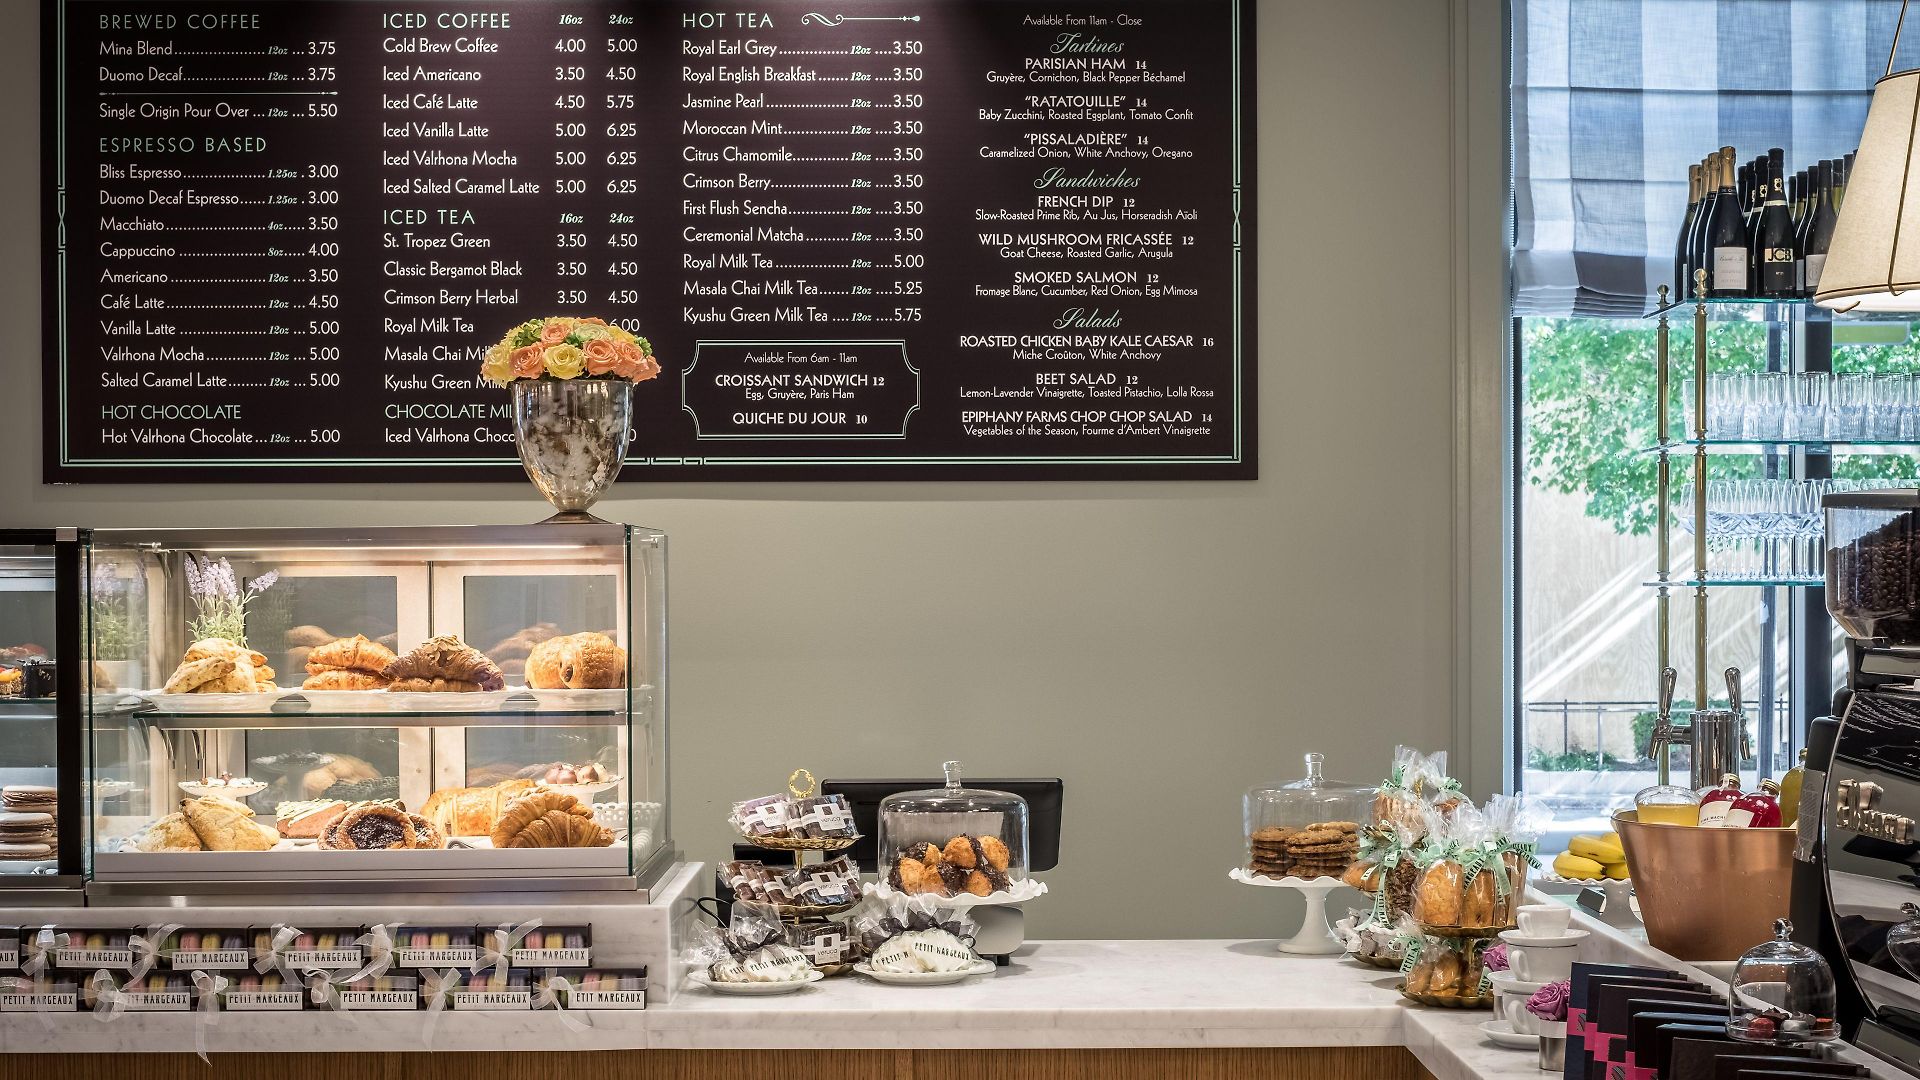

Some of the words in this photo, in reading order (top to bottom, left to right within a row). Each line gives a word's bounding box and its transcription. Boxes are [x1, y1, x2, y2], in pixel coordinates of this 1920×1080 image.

[100, 15, 176, 29] BREWED
[188, 14, 260, 29] COFFEE
[384, 14, 426, 28] ICED
[438, 14, 510, 28] COFFEE
[559, 14, 582, 24] 16oz
[609, 14, 633, 24] 24oz
[684, 13, 725, 28] HOT
[736, 13, 773, 28] TEA
[100, 41, 132, 55] Mina
[268, 46, 288, 54] 12oz
[308, 42, 335, 54] 3.75
[684, 40, 714, 57] Royal
[720, 40, 740, 54] Earl
[850, 46, 871, 54] 12oz
[893, 41, 922, 54] 3.50
[1050, 33, 1124, 53] Tartines
[1026, 58, 1086, 69] PARISIAN
[1092, 58, 1125, 69] HAM
[1136, 61, 1146, 69] 14
[384, 66, 409, 80] Iced
[413, 66, 481, 80] Americano
[556, 67, 584, 80] 3.50
[606, 67, 636, 80] 4.50
[987, 71, 1025, 83] Gruyère,
[1030, 71, 1079, 82] Cornichon,
[1084, 71, 1106, 82] Black
[1109, 71, 1140, 83] Pepper
[1144, 71, 1185, 82] Béchamel
[1137, 99, 1147, 107] 14
[100, 103, 135, 120] Single
[140, 103, 179, 120] Origin
[185, 103, 211, 117] Pour
[216, 103, 249, 117] Over
[268, 108, 288, 117] 12oz
[309, 104, 337, 116] 5.50
[980, 109, 1001, 121] Baby
[1004, 109, 1044, 120] Zucchini,
[1049, 109, 1083, 119] Roasted
[1087, 109, 1125, 121] Eggplant,
[1129, 109, 1162, 119] Tomato
[1165, 109, 1193, 120] Confit
[100, 164, 124, 178] Bliss
[130, 164, 181, 180] Espresso
[268, 169, 297, 178] 1.25oz
[309, 165, 338, 178] 3.00
[1034, 168, 1140, 188] Sandwiches
[384, 179, 409, 193] Iced
[414, 179, 450, 193] Salted
[455, 179, 504, 193] Caramel
[510, 179, 539, 193] Latte
[556, 180, 586, 193] 5.00
[607, 180, 636, 193] 6.25
[1038, 196, 1087, 207] FRENCH
[1093, 196, 1113, 207] DIP
[1124, 199, 1134, 207] 12
[384, 210, 426, 224] ICED
[438, 210, 474, 224] TEA
[560, 213, 583, 223] 16oz
[610, 213, 634, 223] 24oz
[976, 209, 1034, 220] Slow-Roasted
[1037, 209, 1060, 220] Prime
[1064, 209, 1079, 220] Rib,
[1083, 210, 1097, 220] Au
[1100, 210, 1118, 220] Jus,
[1122, 209, 1172, 220] Horseradish
[1176, 209, 1197, 220] Aïoli
[1768, 248, 1792, 261] JCB
[384, 261, 426, 276] Classic
[430, 261, 486, 278] Bergamot
[491, 261, 522, 275] Black
[558, 262, 586, 275] 3.50
[608, 262, 637, 275] 4.50
[1015, 272, 1071, 283] SMOKED
[1077, 272, 1136, 283] SALMON
[1148, 274, 1158, 282] 12
[976, 285, 1010, 297] Fromage
[1013, 285, 1038, 296] Blanc,
[1041, 285, 1088, 296] Cucumber,
[1092, 285, 1108, 295] Red
[1111, 285, 1142, 296] Onion,
[1146, 285, 1160, 297] Egg
[1163, 285, 1197, 295] Mimosa
[684, 307, 725, 324] Kyushu
[731, 307, 770, 322] Green
[775, 307, 803, 321] Milk
[807, 307, 827, 321] Tea
[852, 313, 871, 321] 12oz
[895, 308, 921, 321] 5.75
[1053, 308, 1122, 329] Salads
[101, 320, 140, 334] Vanilla
[146, 320, 175, 334] Latte
[269, 326, 289, 334] 12oz
[310, 321, 339, 334] 5.00
[961, 336, 1017, 347] ROASTED
[1021, 336, 1071, 347] CHICKEN
[1076, 336, 1107, 346] BABY
[1110, 336, 1141, 346] KALE
[1145, 335, 1193, 346] CAESAR
[1203, 338, 1214, 346] 16
[1013, 349, 1042, 359] Miche
[1046, 348, 1085, 360] Croûton,
[1089, 349, 1117, 359] White
[1120, 349, 1161, 361] Anchovy
[716, 375, 790, 386] CROISSANT
[795, 374, 867, 386] SANDWICH
[873, 377, 884, 386] 12
[746, 388, 764, 400] Egg,
[768, 388, 806, 400] Gruyère,
[811, 388, 829, 398] Paris
[833, 388, 854, 398] Ham
[102, 405, 136, 419] HOT
[141, 405, 241, 419] CHOCOLATE
[576, 993, 594, 1002] ETIT
